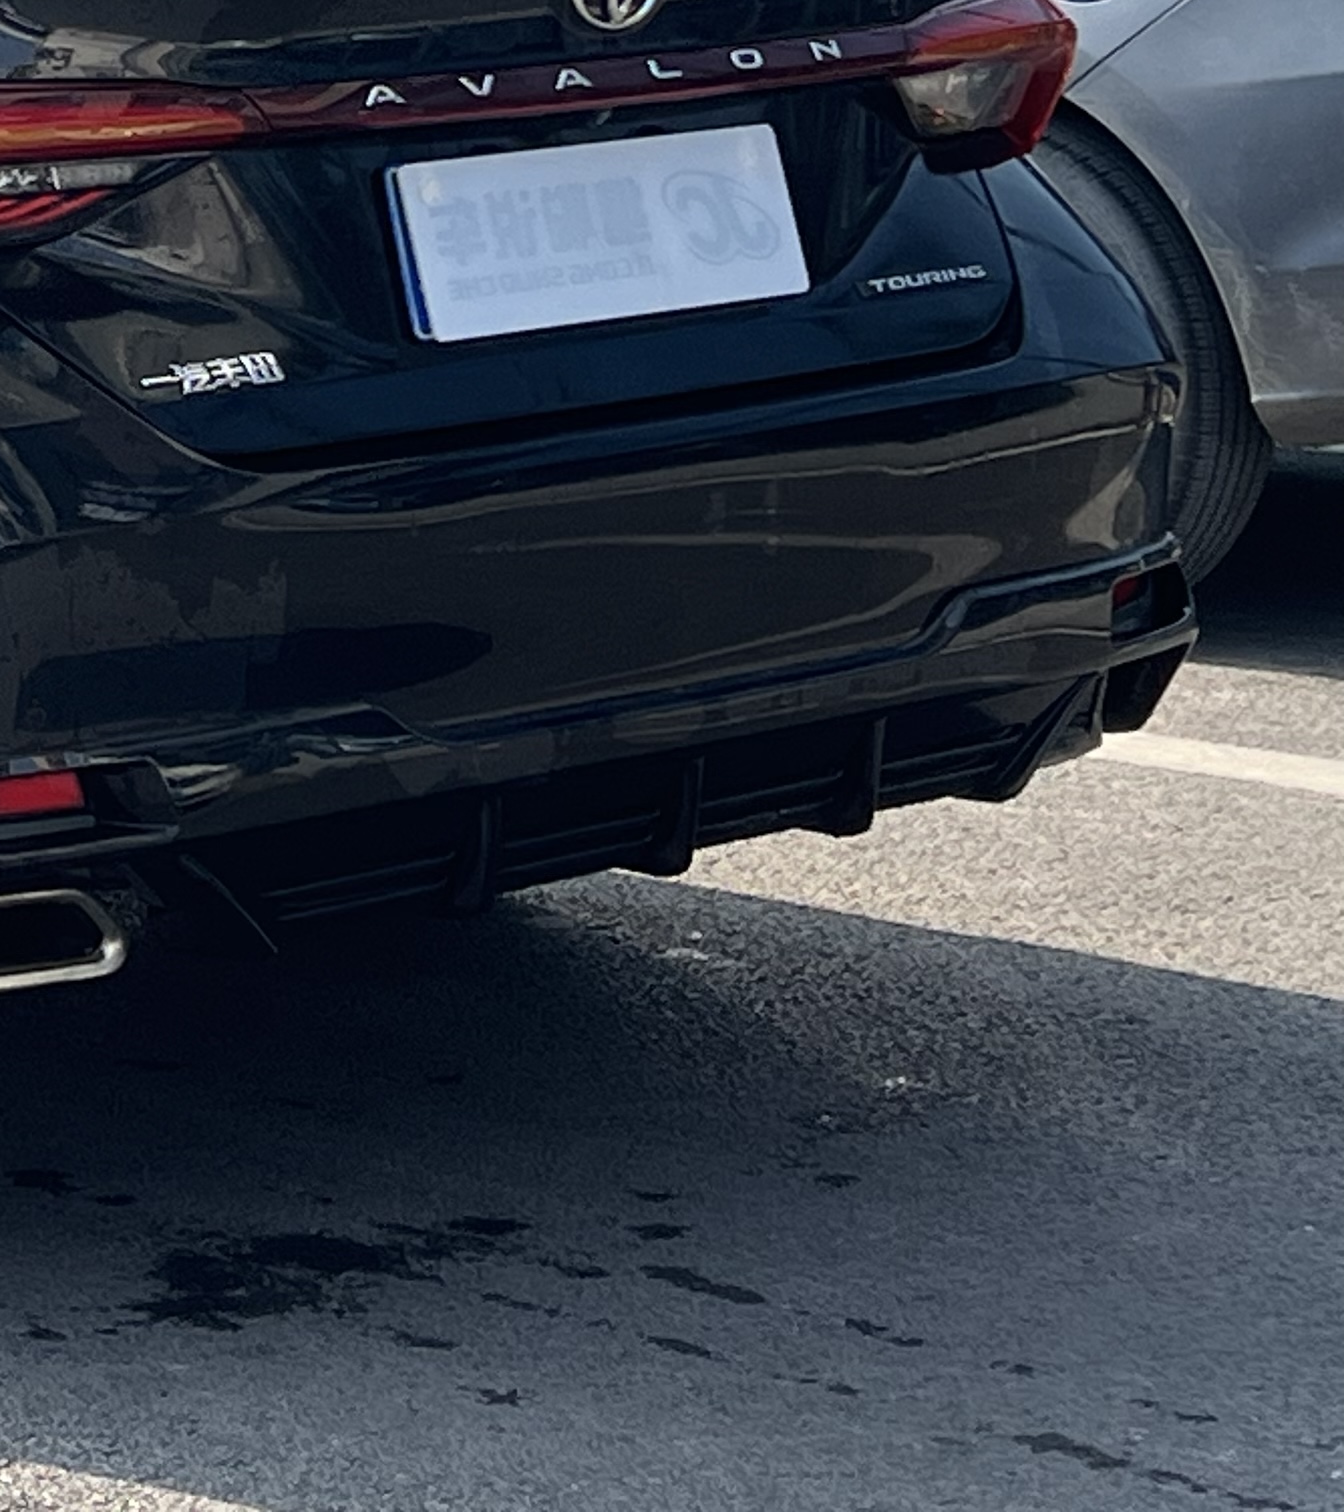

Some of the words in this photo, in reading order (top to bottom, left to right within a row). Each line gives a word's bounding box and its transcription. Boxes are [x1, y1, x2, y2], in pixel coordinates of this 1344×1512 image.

[365, 37, 844, 109] AVALON
[868, 265, 987, 293] TOURING
[141, 351, 286, 395] 一汽丰田
